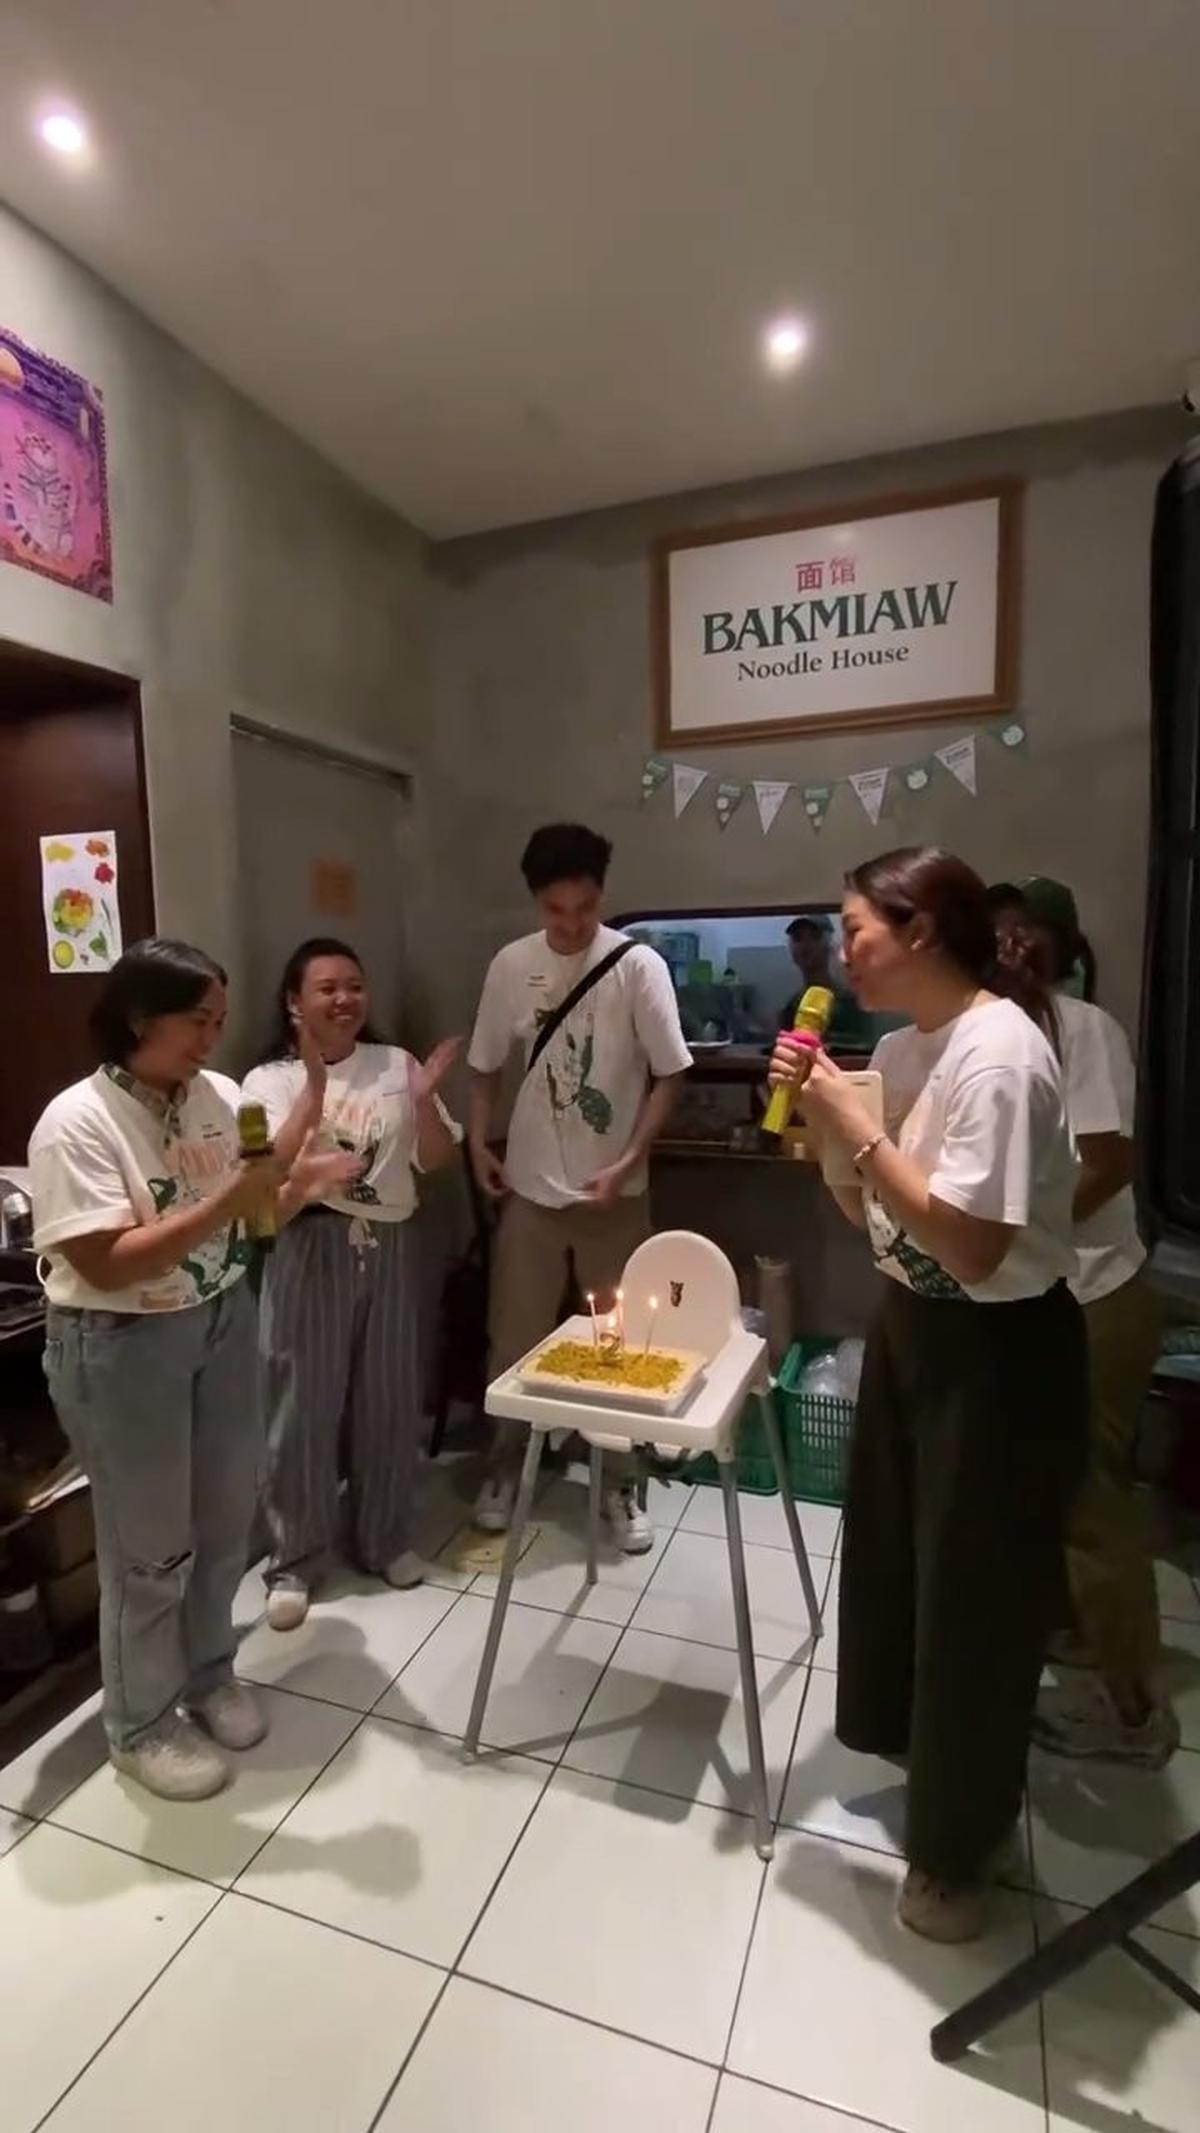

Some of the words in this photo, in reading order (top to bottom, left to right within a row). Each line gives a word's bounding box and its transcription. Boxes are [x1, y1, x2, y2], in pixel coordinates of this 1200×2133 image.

[796, 557, 856, 592] 面馆
[703, 580, 958, 655] BAKMIAW
[738, 651, 822, 681] Noodle
[831, 646, 909, 670] House
